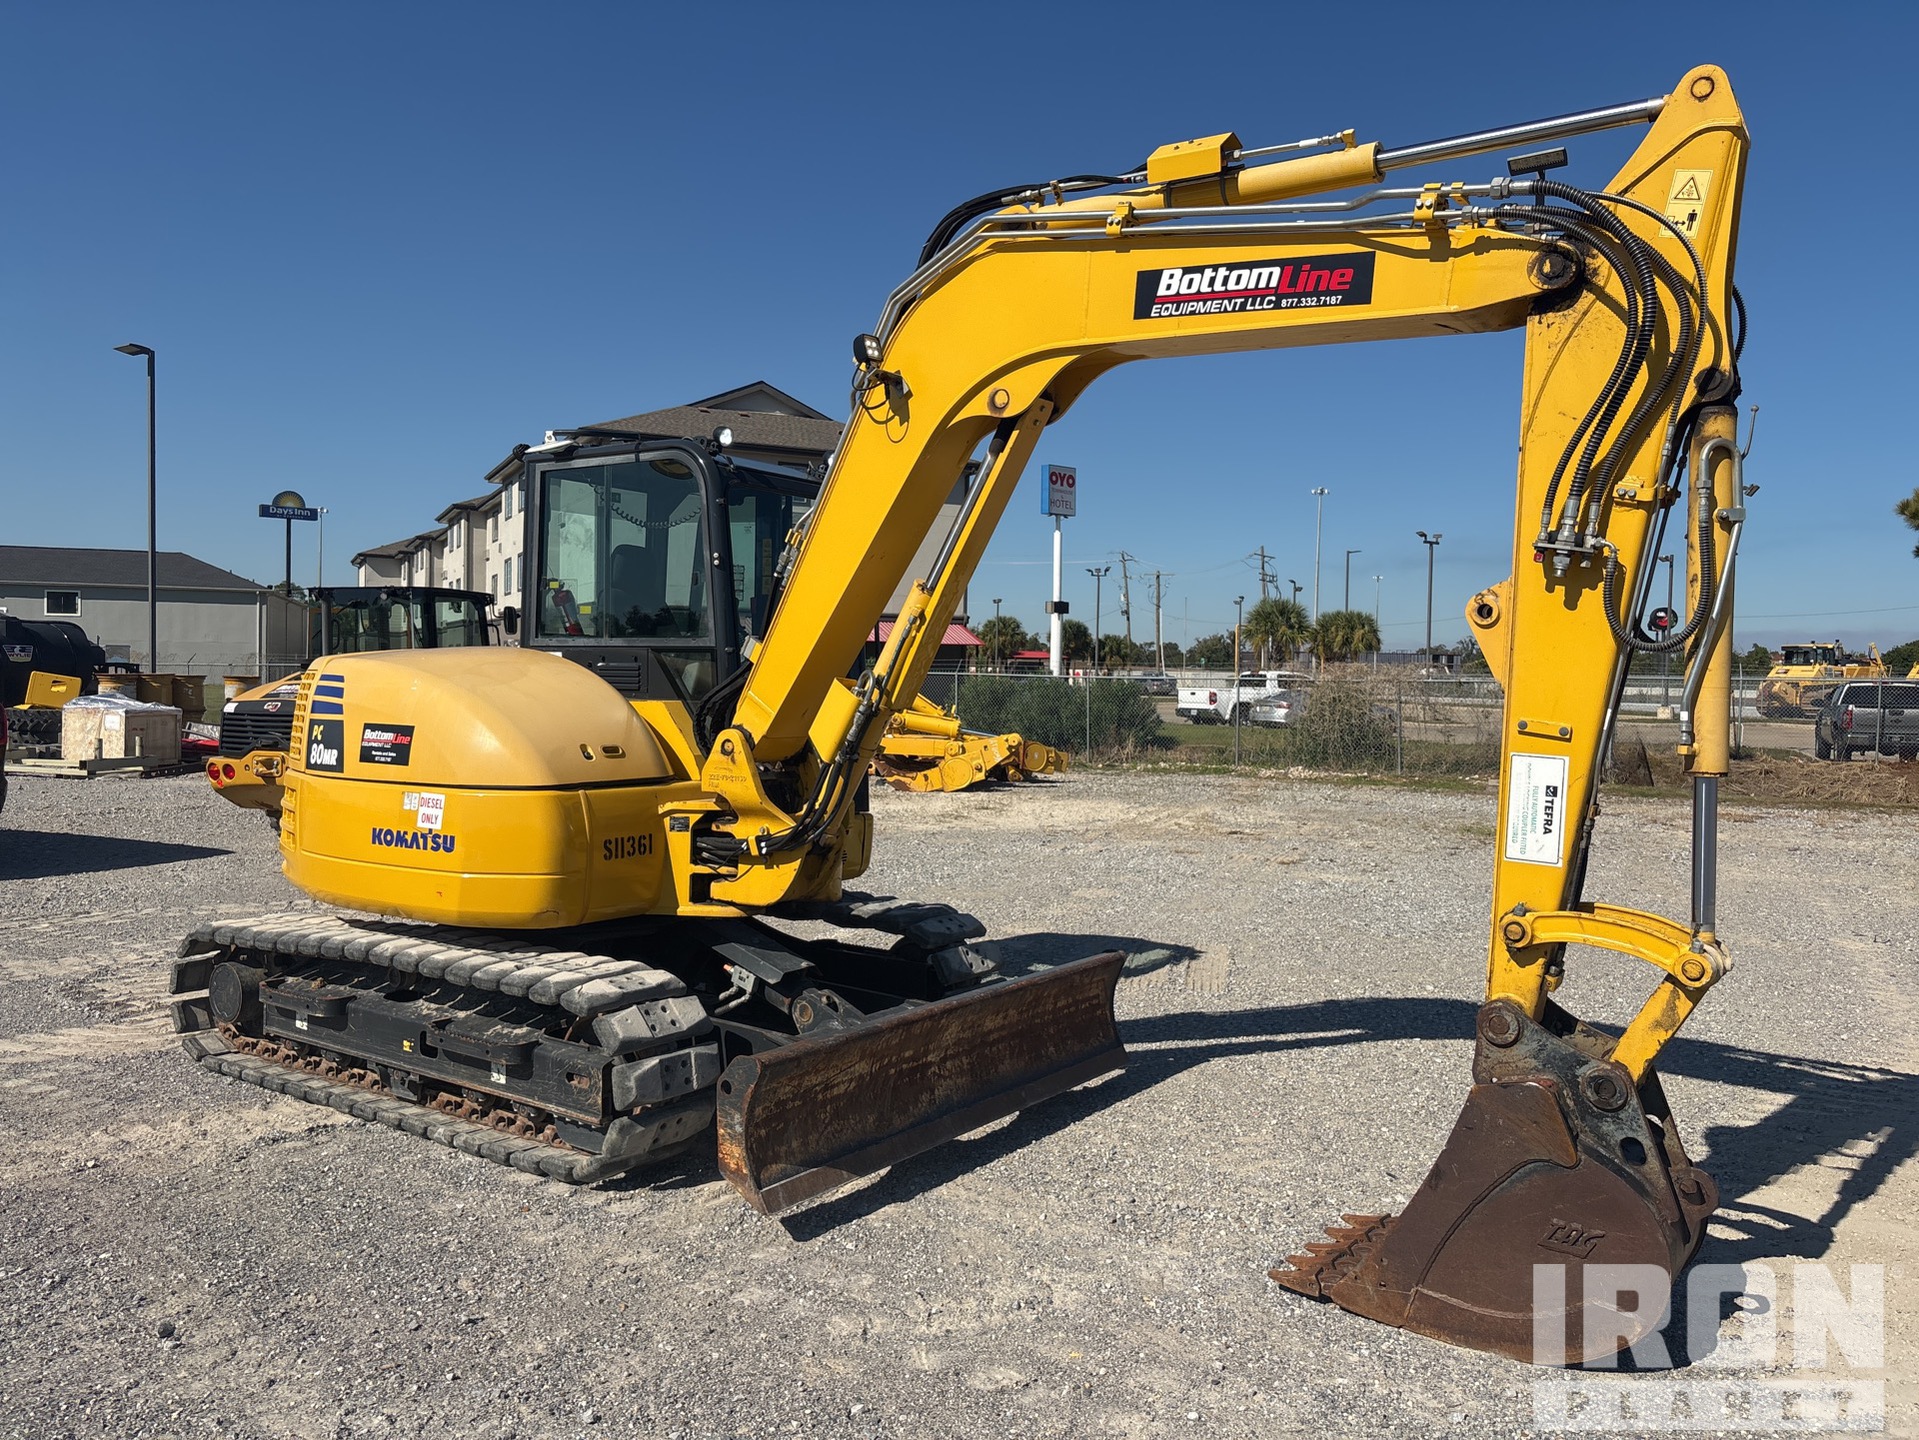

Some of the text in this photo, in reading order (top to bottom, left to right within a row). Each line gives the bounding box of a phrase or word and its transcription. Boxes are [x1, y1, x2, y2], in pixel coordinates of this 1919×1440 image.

[1155, 264, 1354, 297] BottomLine
[1150, 295, 1343, 317] EQUIPMENT LLC 877.332.7187
[1049, 471, 1076, 488] OYO
[269, 506, 310, 516] Days Inn
[1050, 499, 1073, 510] HOTEL
[311, 724, 324, 741] PC
[364, 729, 410, 744] BottomLine
[310, 742, 338, 766] 80MR
[420, 796, 444, 810] DIESEL
[421, 812, 439, 825] ONLY
[1530, 802, 1538, 834] AUTOMATIC
[1542, 798, 1555, 835] TEFRA
[371, 827, 456, 854] KOMATSU
